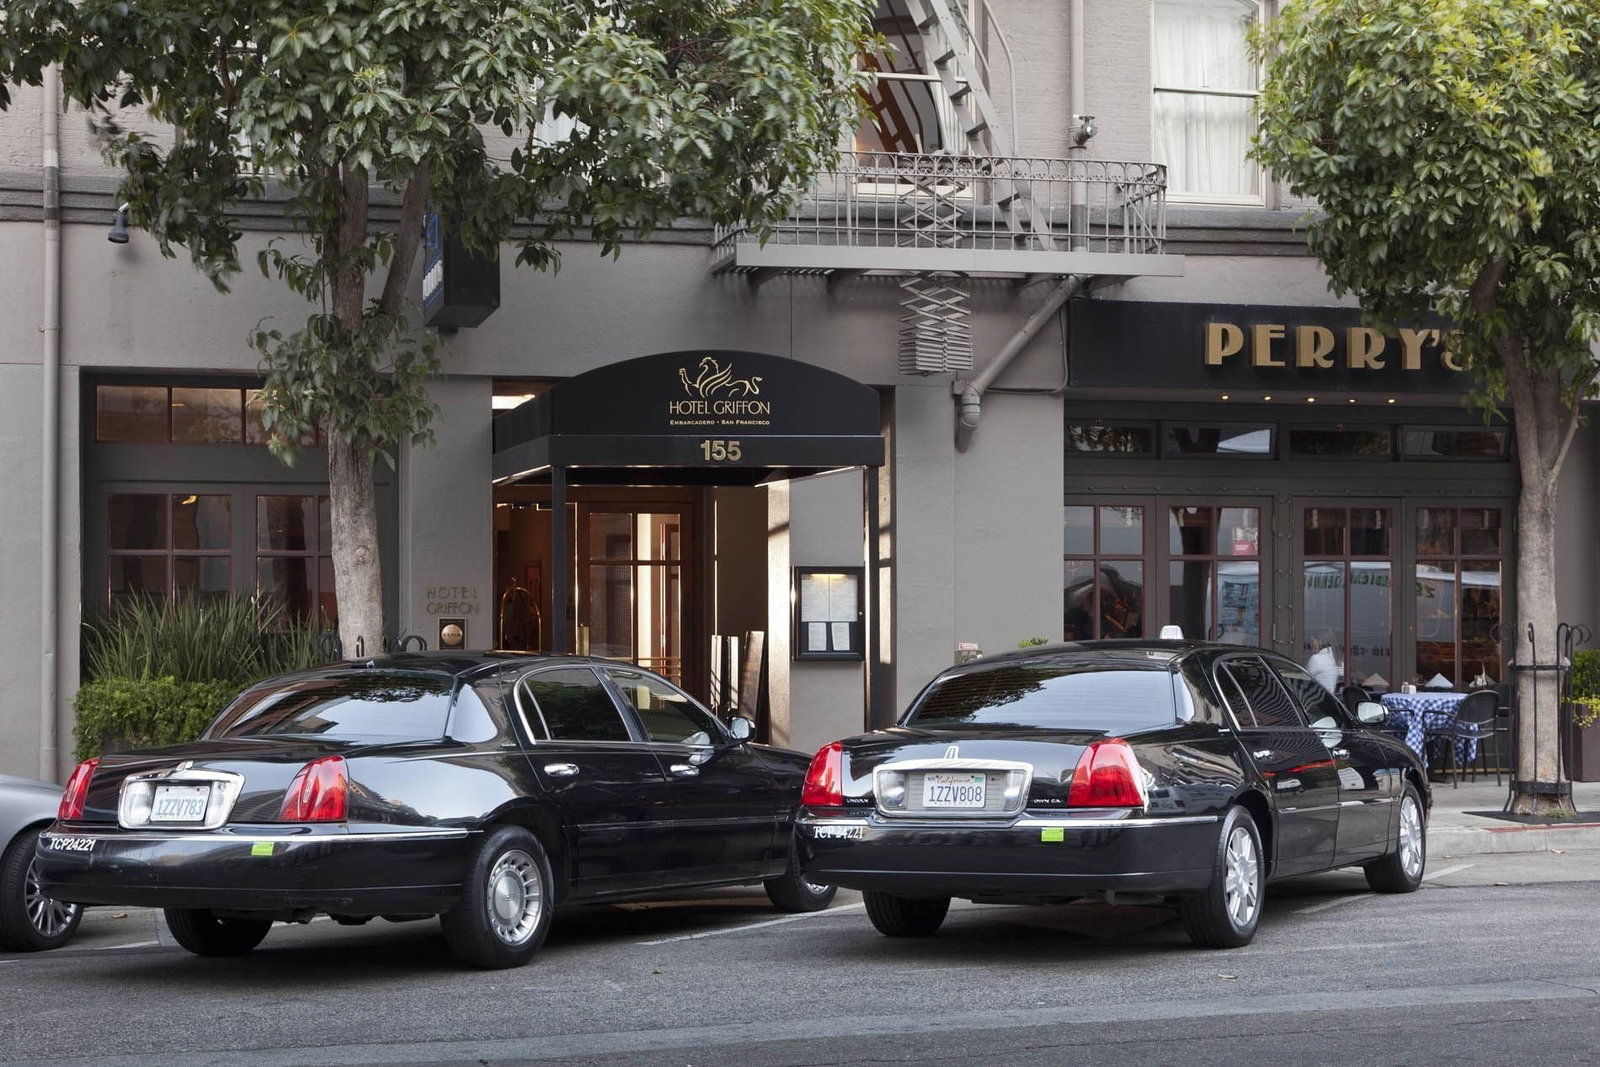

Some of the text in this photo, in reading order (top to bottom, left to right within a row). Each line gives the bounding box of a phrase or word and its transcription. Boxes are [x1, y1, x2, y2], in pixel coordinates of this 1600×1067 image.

[1204, 323, 1473, 371] PERRY'S
[669, 400, 771, 415] HOTEL GRIFFON
[700, 440, 742, 461] 155
[426, 586, 478, 600] HOTEL
[928, 785, 983, 803] 1ZZV808
[155, 798, 205, 817] 1ZZV783
[49, 838, 97, 852] TCP24221
